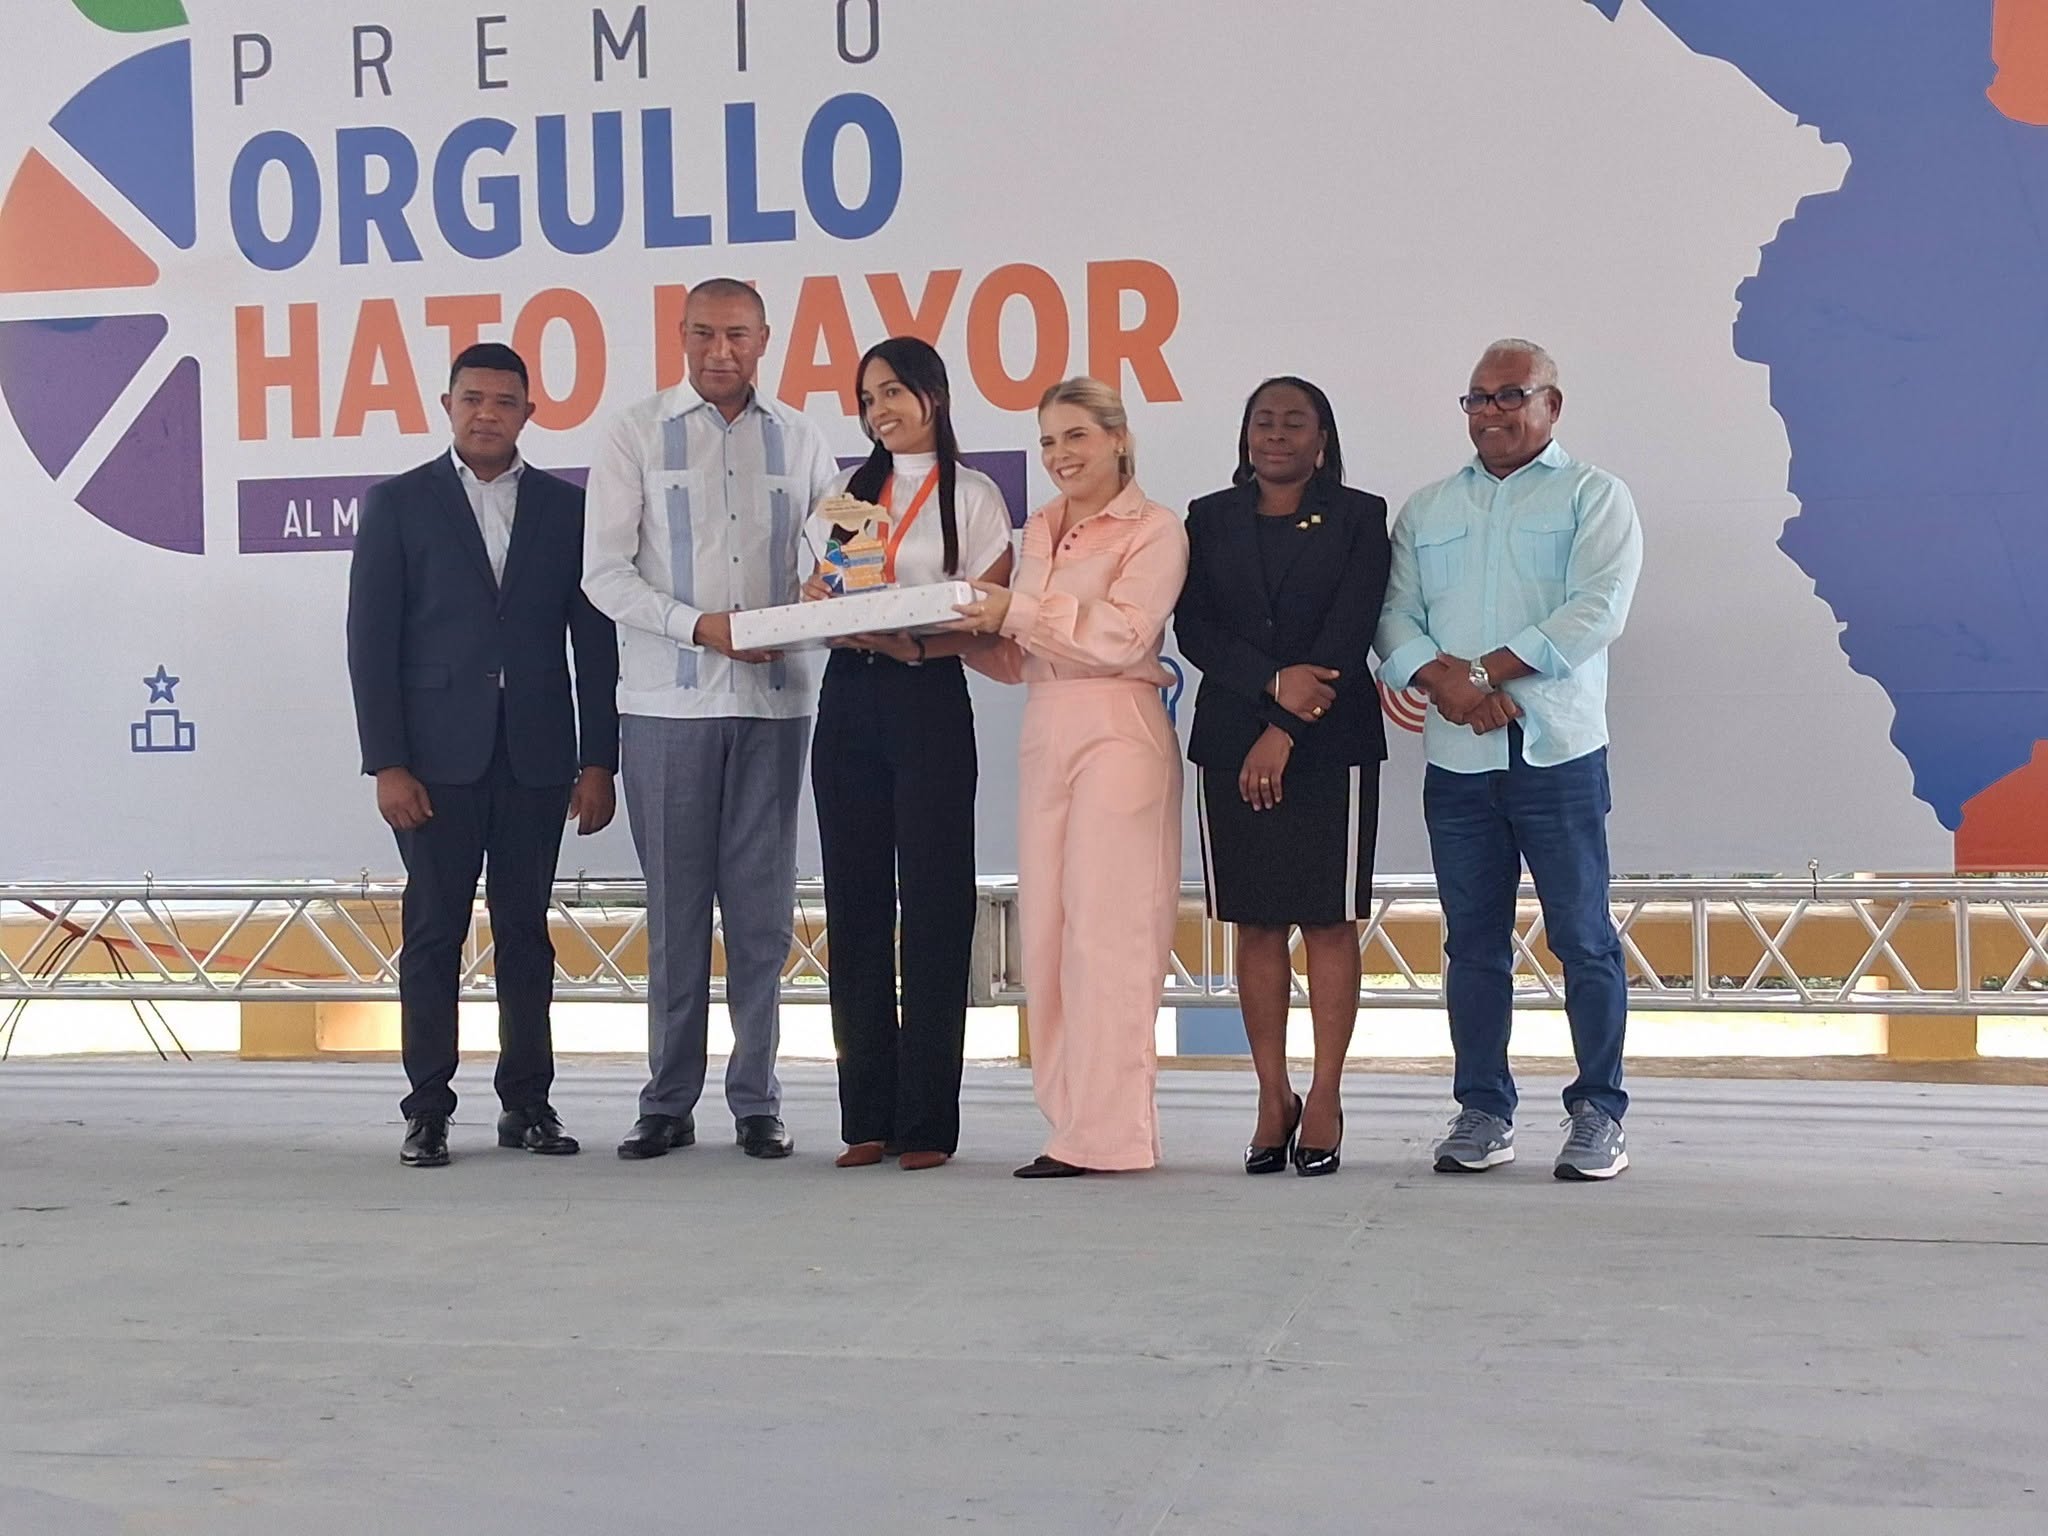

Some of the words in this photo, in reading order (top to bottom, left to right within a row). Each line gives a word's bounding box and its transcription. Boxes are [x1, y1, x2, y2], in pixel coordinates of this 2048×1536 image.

[232, 0, 880, 106] PREMIO
[229, 92, 903, 271] ORGULLO
[235, 287, 607, 441] HATO
[283, 499, 322, 538] AL
